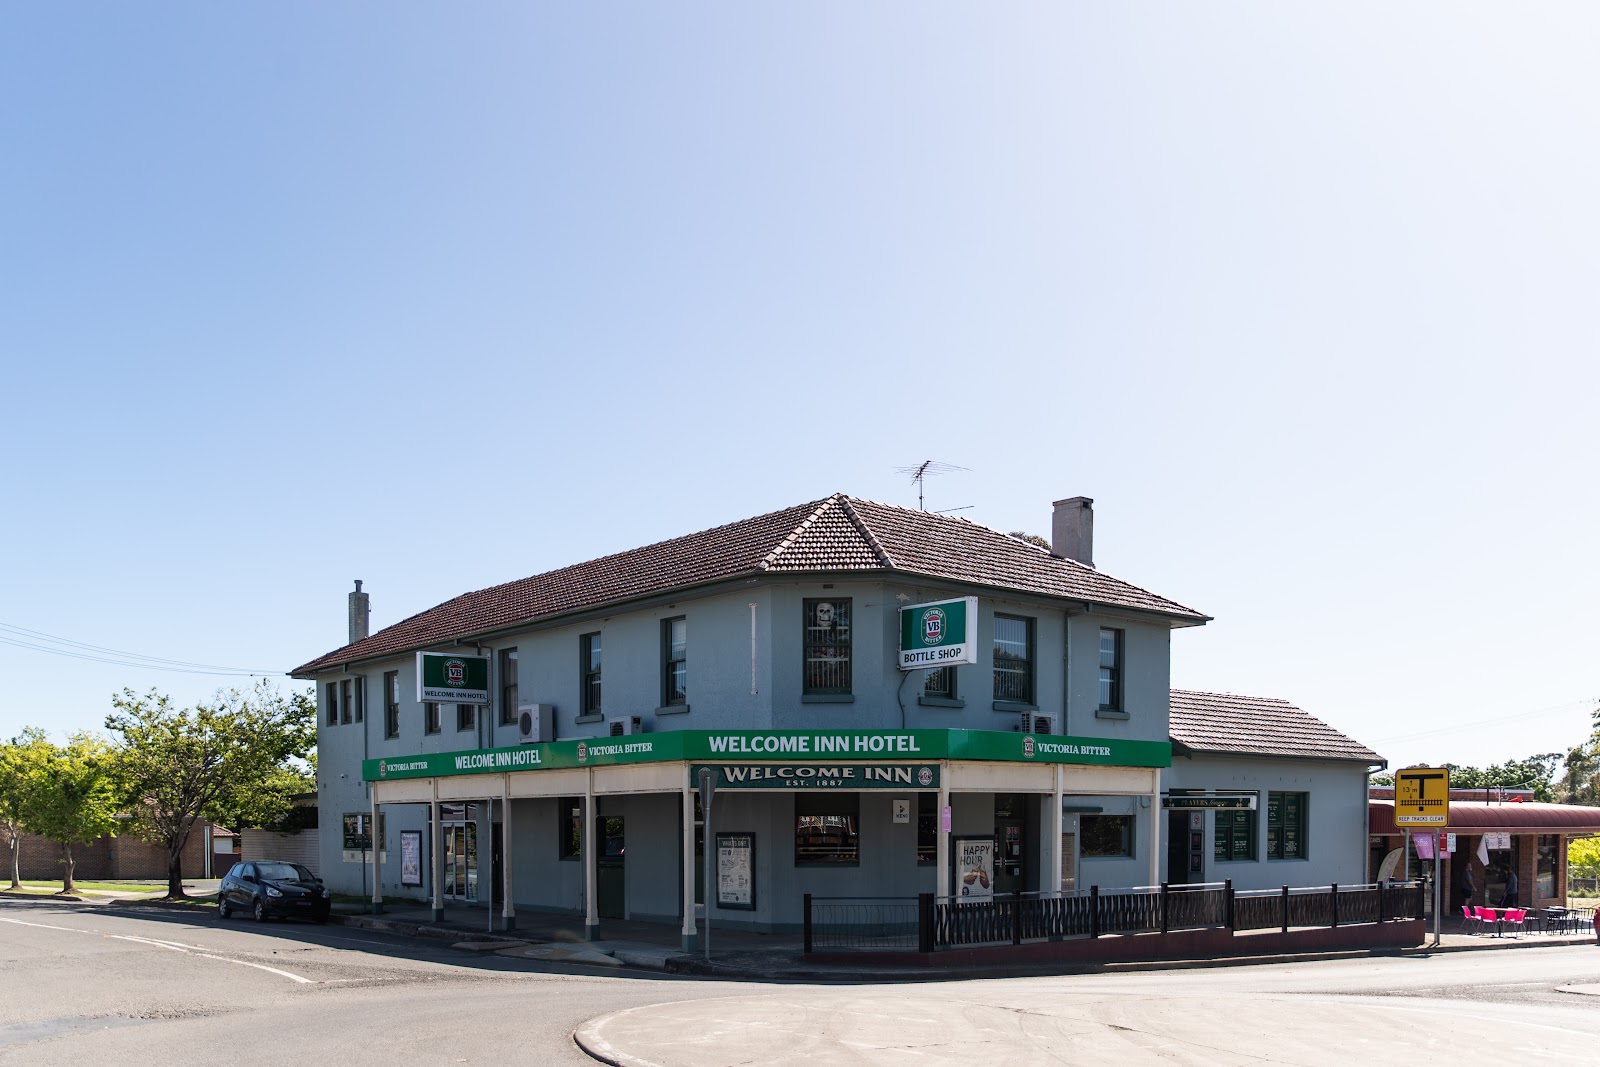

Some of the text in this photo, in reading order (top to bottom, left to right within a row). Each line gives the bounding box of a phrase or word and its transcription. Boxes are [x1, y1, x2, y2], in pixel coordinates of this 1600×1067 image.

[923, 609, 944, 620] VICTORIA
[927, 621, 940, 632] VB
[925, 635, 943, 644] BITTER
[904, 647, 962, 663] BOTTLE SHOP
[449, 668, 462, 677] VB
[589, 745, 624, 756] VICTORIA
[624, 743, 653, 753] BITTER
[708, 735, 921, 753] WELCOME INN HOTEL
[1037, 743, 1111, 756] VICTORIA BITTER
[455, 750, 542, 770] WELCOME INN HOTEL
[387, 762, 410, 772] VICTORIA
[410, 761, 428, 770] BITTER
[722, 767, 855, 783] WELCOME
[864, 767, 912, 784] INN
[963, 845, 991, 856] HAPPY
[959, 855, 984, 866] HOUR
